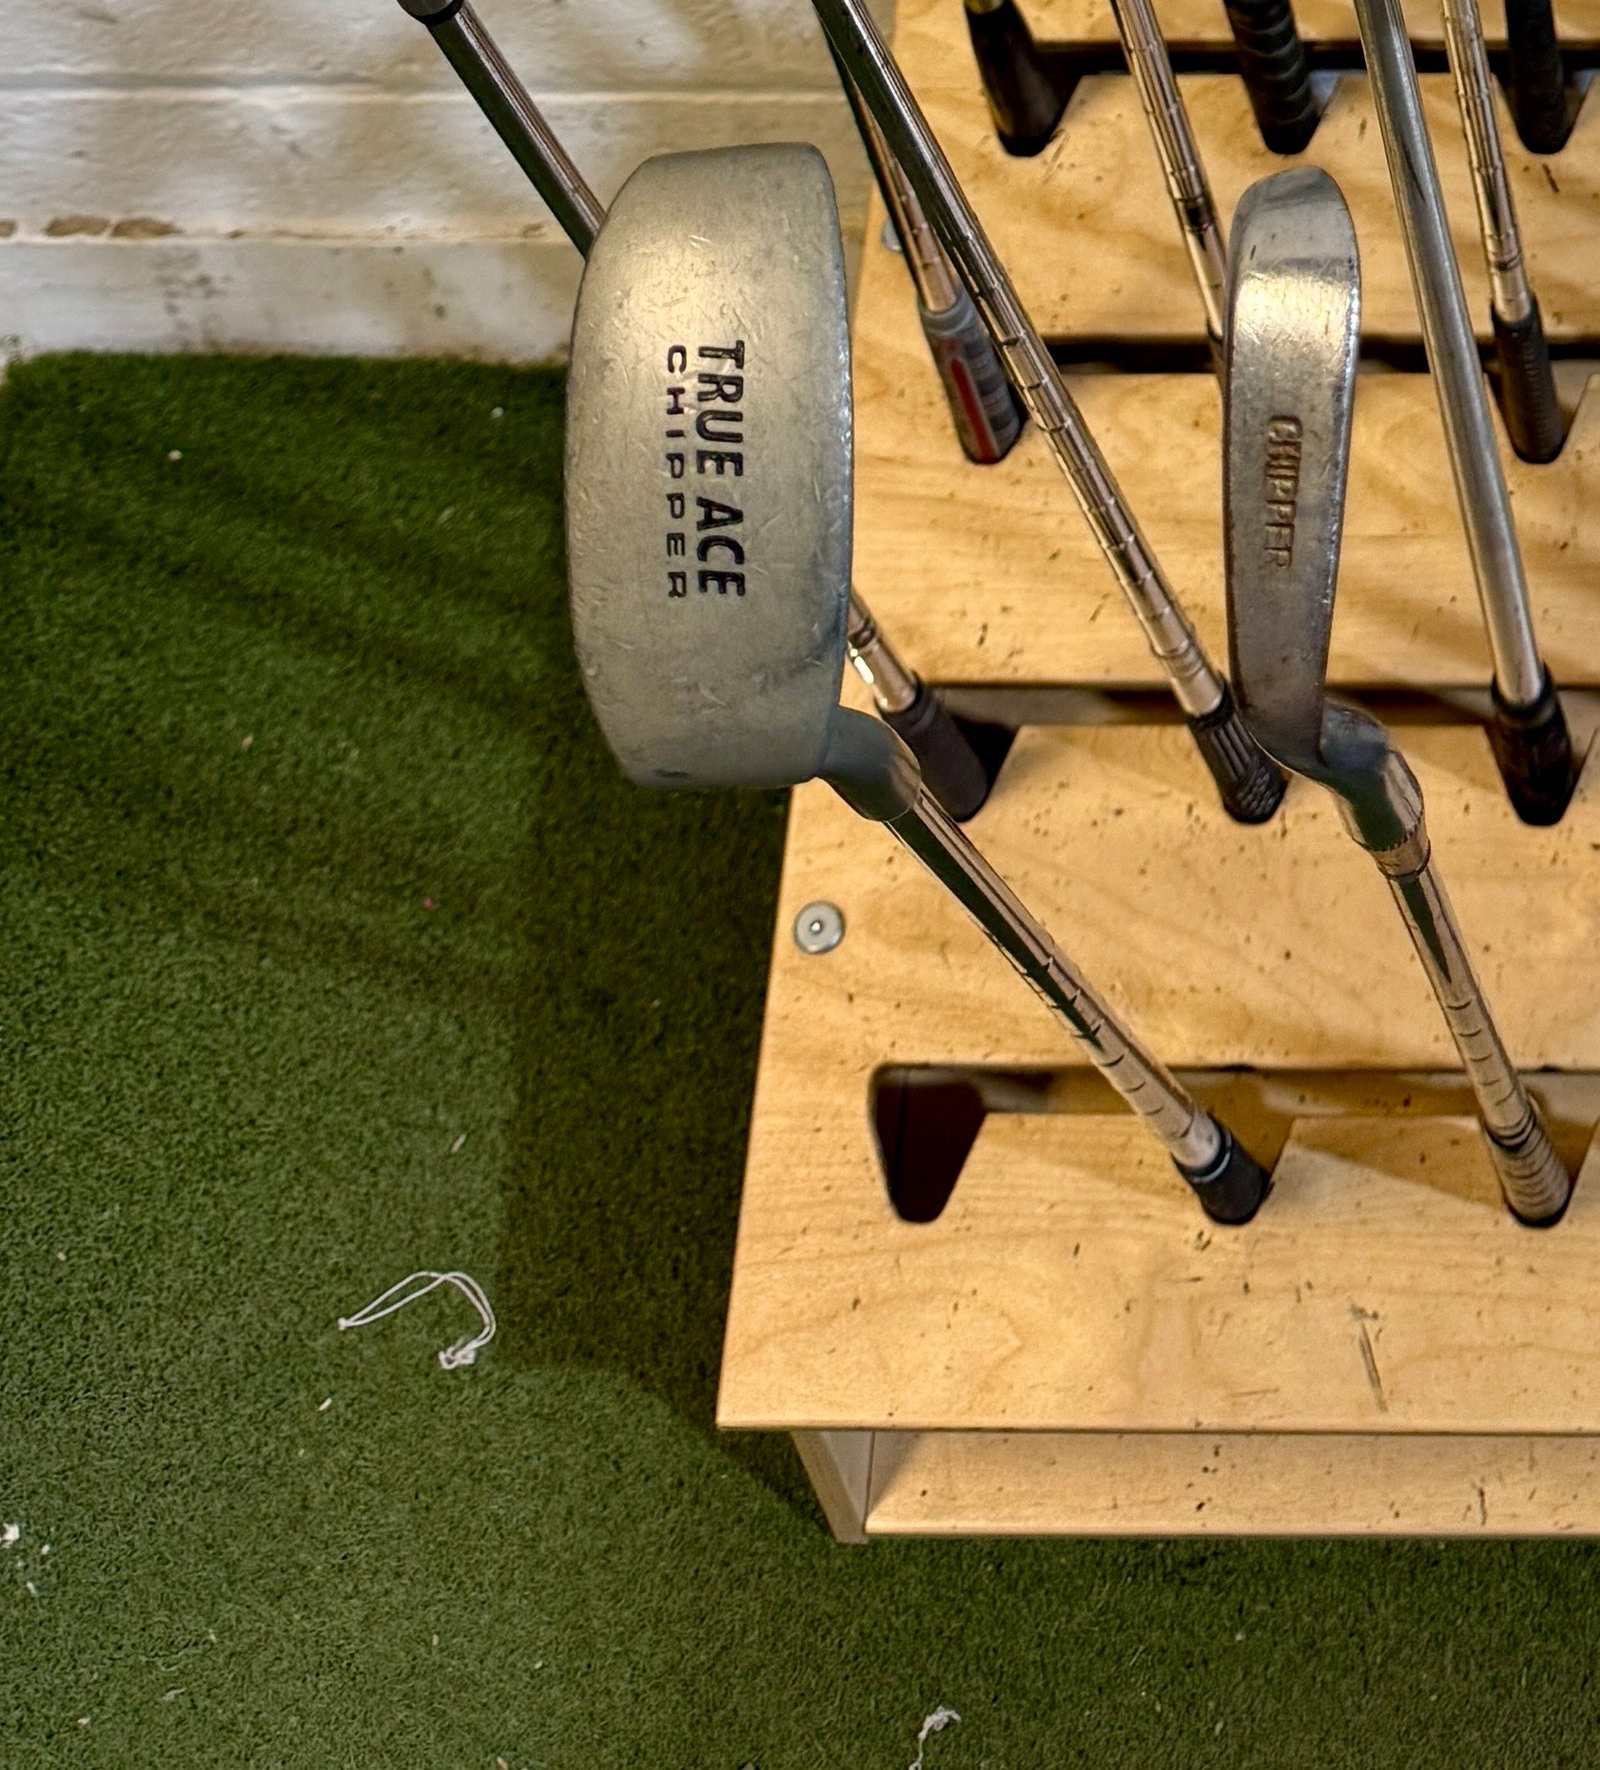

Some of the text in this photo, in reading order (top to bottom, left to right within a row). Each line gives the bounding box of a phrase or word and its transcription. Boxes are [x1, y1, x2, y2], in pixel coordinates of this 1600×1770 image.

[666, 343, 688, 600] CHIPPER
[696, 340, 746, 599] TRUE ACE
[1264, 416, 1303, 570] CHIPPER
